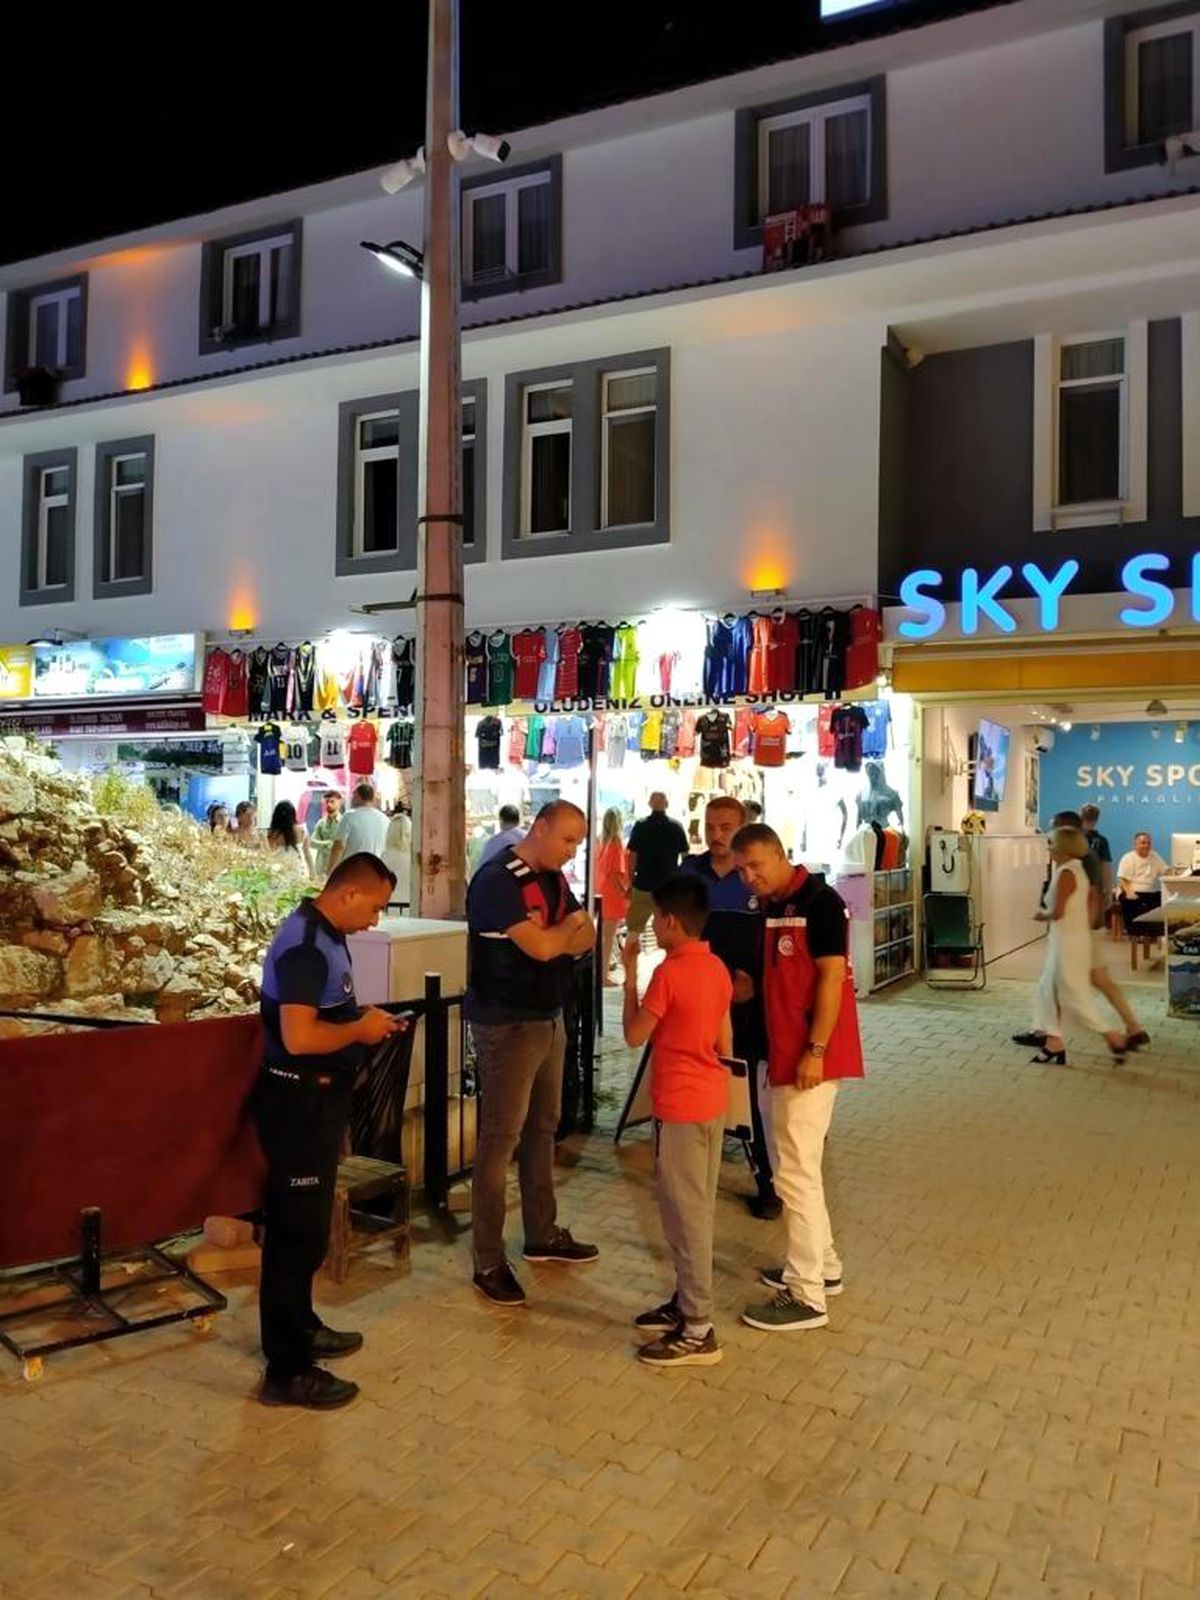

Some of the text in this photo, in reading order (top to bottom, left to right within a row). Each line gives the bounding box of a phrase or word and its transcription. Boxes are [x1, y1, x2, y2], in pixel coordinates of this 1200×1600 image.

[898, 552, 1200, 639] SKY S
[347, 701, 415, 719] SPEN
[1076, 764, 1135, 788] SKY
